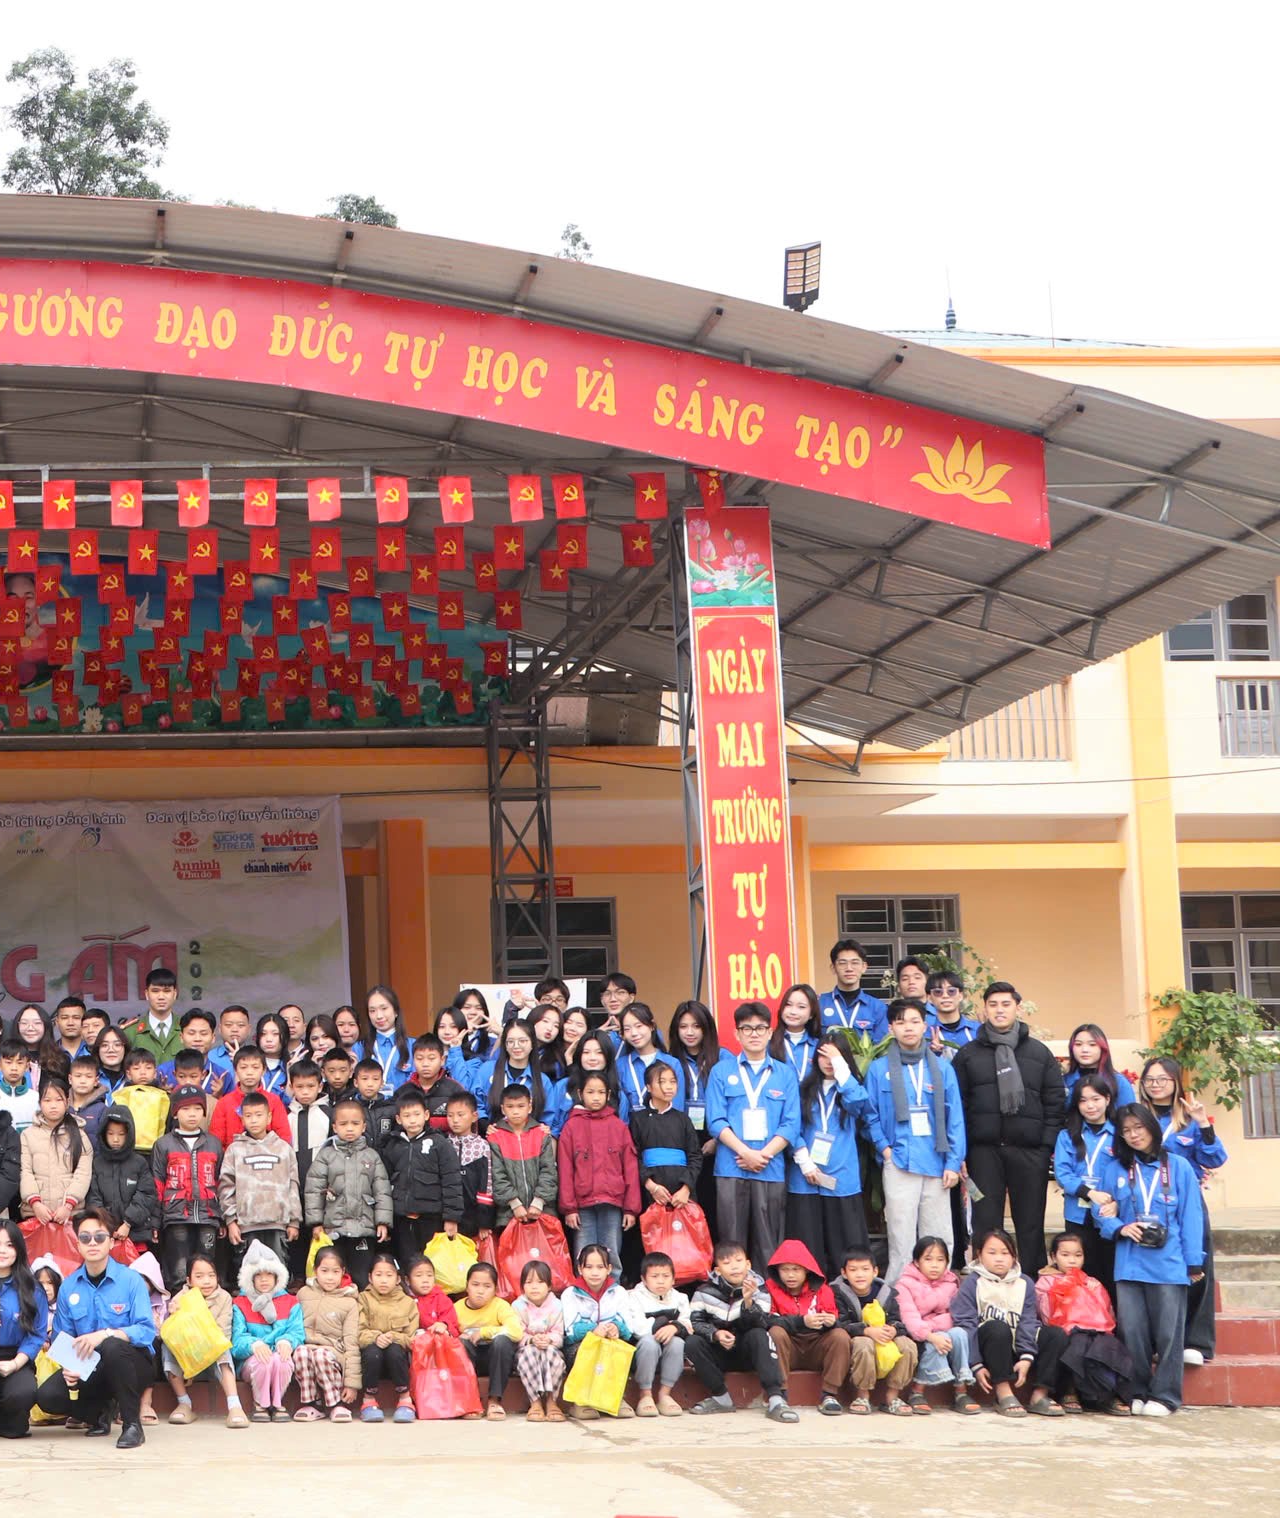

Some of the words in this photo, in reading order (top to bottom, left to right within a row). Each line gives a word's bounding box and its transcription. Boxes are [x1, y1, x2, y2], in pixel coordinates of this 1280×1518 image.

[154, 302, 237, 359] ĐẠO
[268, 305, 363, 377] ĐỨC,
[383, 331, 446, 390] TỰ
[462, 344, 549, 406] HỌC
[575, 357, 617, 417] VÀ
[652, 378, 766, 448] SÁNG
[794, 413, 904, 476] TẠO”
[705, 635, 767, 694] NGÀY
[715, 720, 767, 769] MAI
[15, 815, 33, 828] tài
[36, 815, 54, 829] trợ
[92, 813, 126, 826] hành
[146, 811, 173, 824] Đơn
[175, 811, 188, 826] vị
[218, 810, 236, 826] trợ
[281, 807, 320, 822] thông
[711, 784, 783, 845] TRƯỜNG
[731, 863, 769, 931] TỰ
[727, 938, 784, 1000] HÀO
